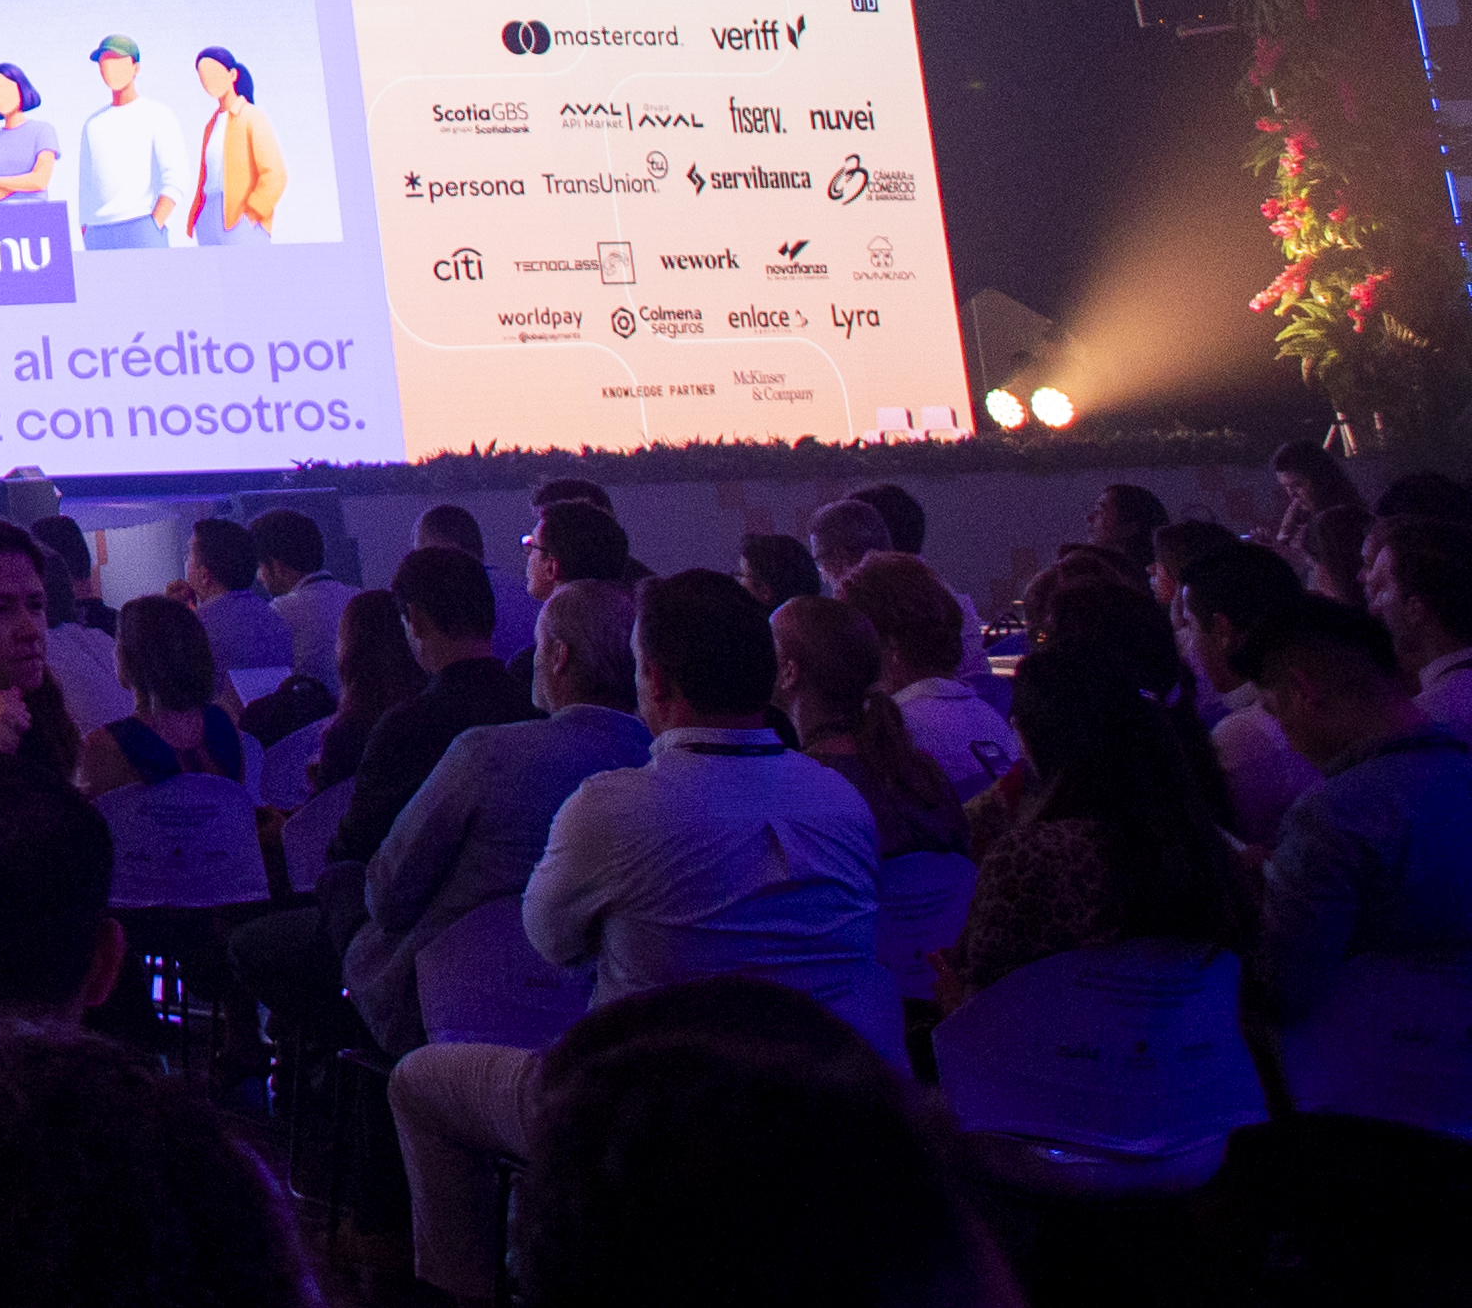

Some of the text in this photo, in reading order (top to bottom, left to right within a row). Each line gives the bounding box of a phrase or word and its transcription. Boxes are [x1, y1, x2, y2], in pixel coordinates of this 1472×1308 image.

[711, 19, 779, 51] veriff
[432, 103, 528, 122] ScotiaGBS
[810, 101, 875, 131] nuvei
[710, 166, 812, 189] servibanca
[429, 180, 525, 204] persona
[433, 247, 483, 281] citi
[660, 248, 740, 270] wework
[766, 262, 828, 275] novafianza
[498, 307, 582, 329] worldpay
[639, 306, 702, 322] Colmena
[728, 305, 790, 329] enlace
[831, 304, 880, 339] Lyra
[651, 322, 704, 339] seguros
[14, 335, 53, 382] al
[68, 330, 255, 379] crédito
[268, 339, 354, 383] por
[733, 370, 786, 385] McKinsey
[602, 384, 715, 398] KNOWLEDGE PARTNER
[752, 386, 814, 404] & Company
[16, 407, 114, 441] con
[128, 395, 366, 437] nosotros.
